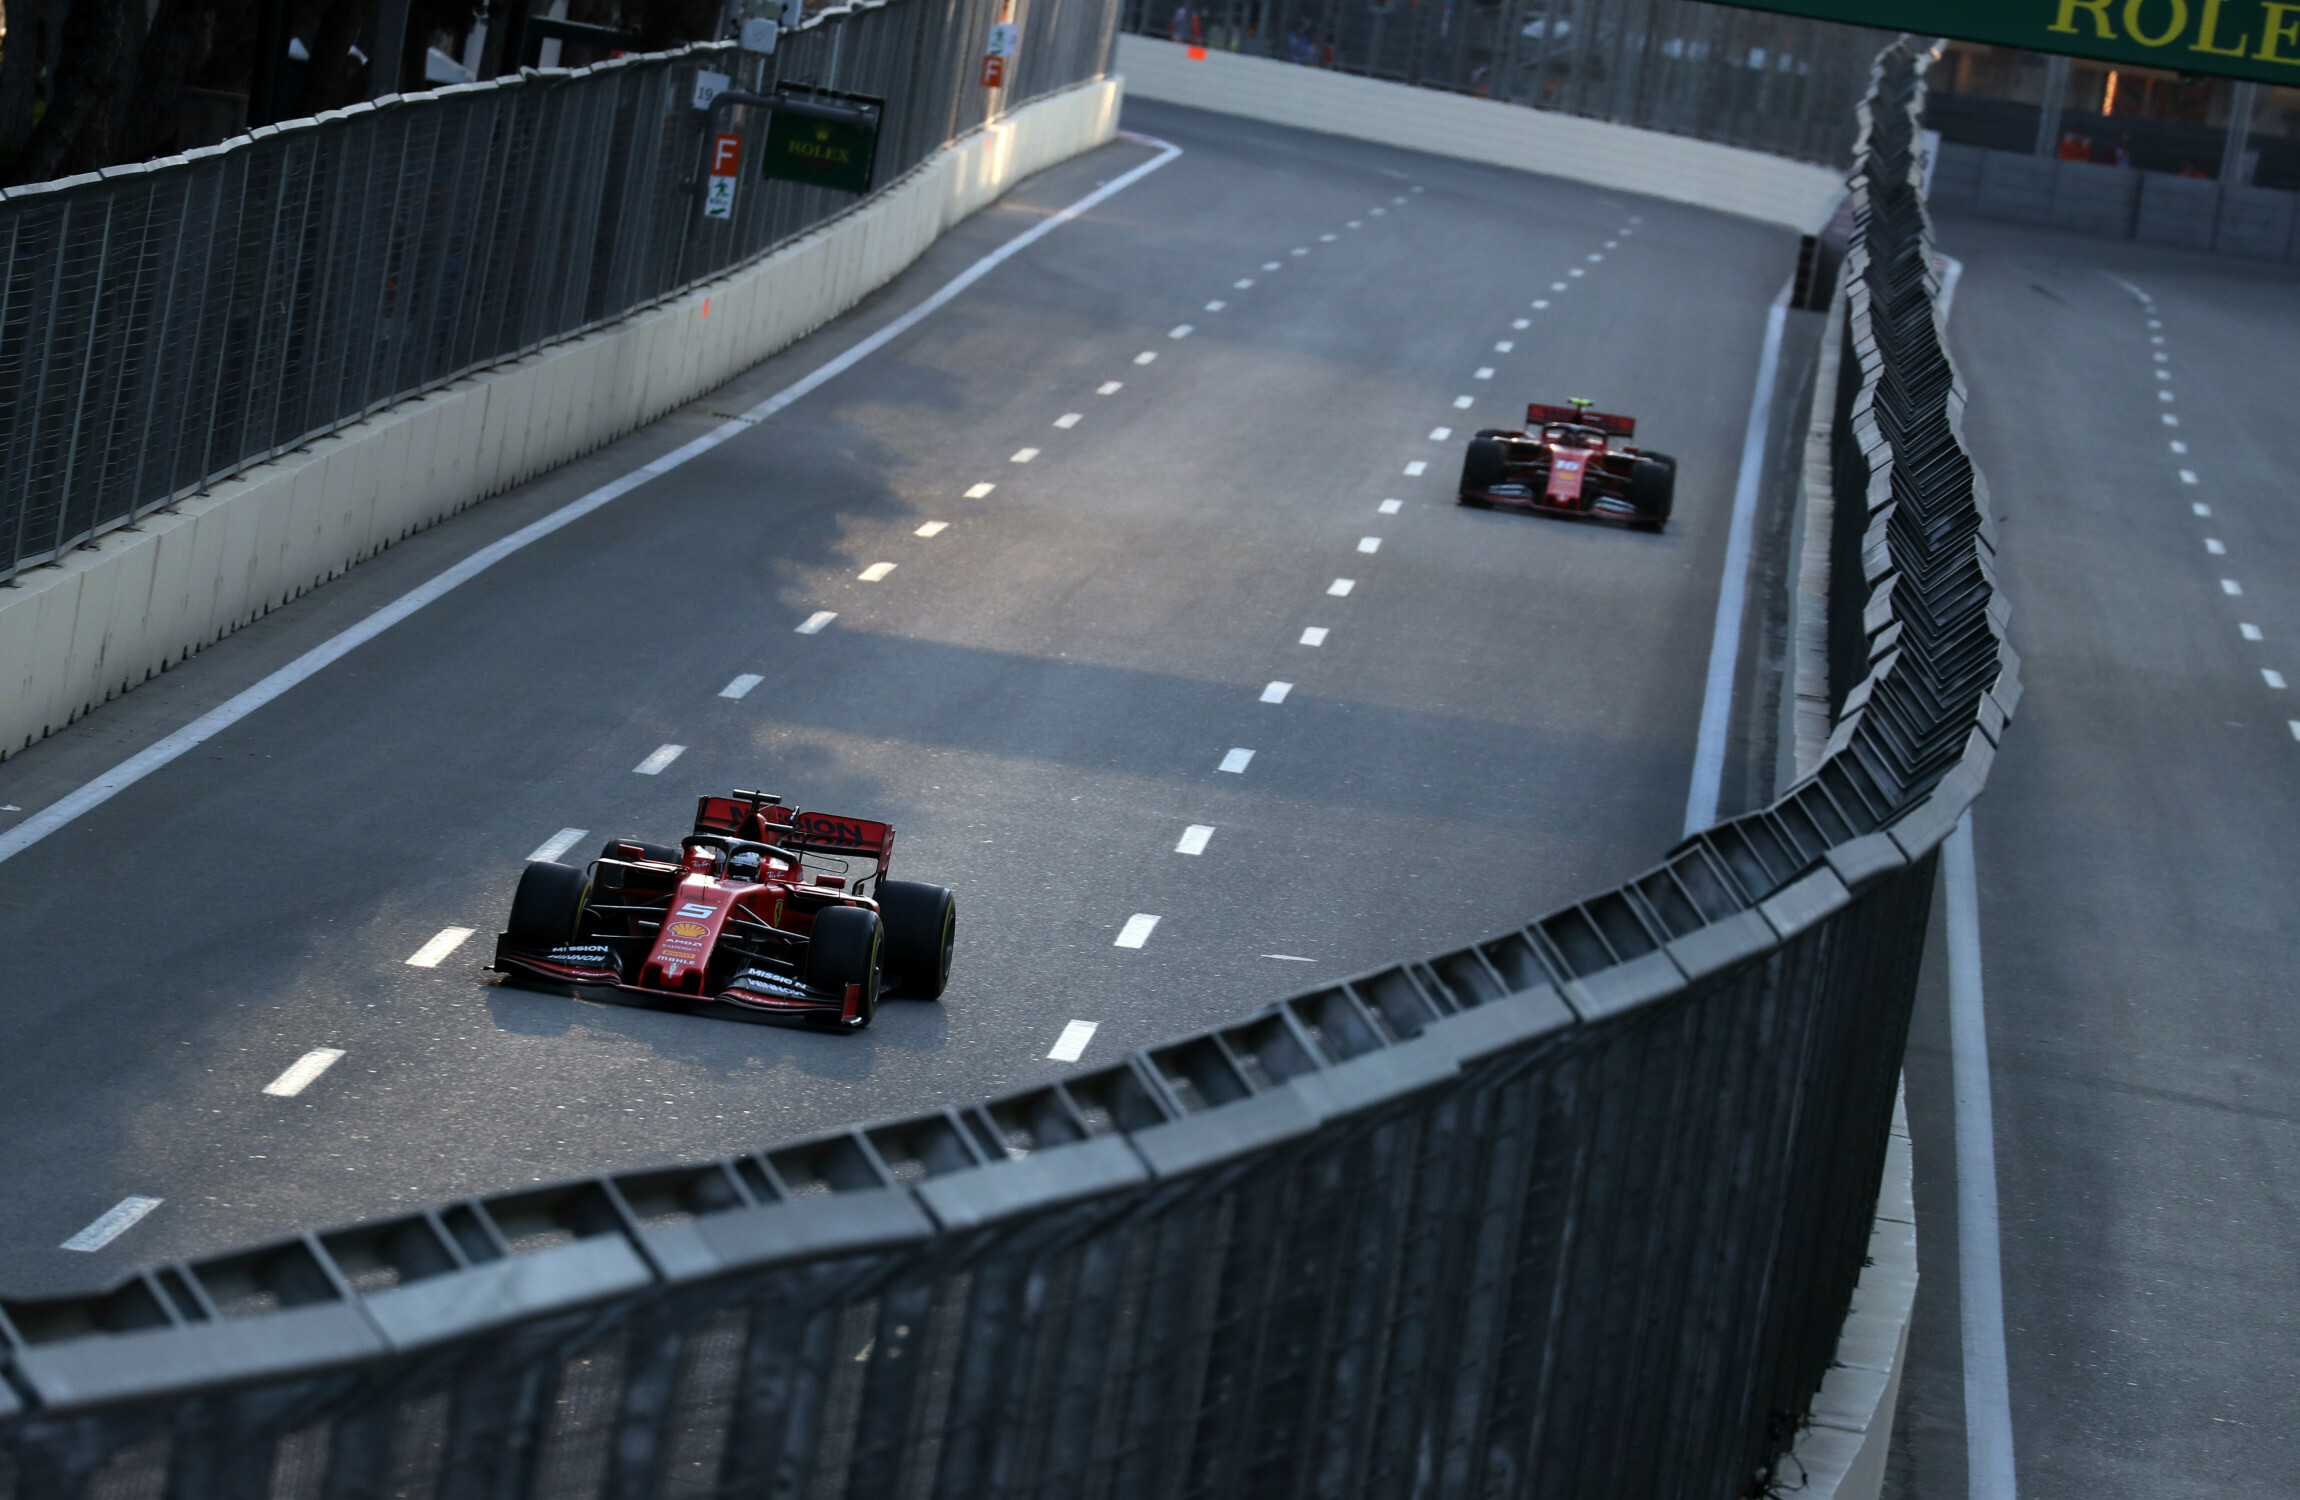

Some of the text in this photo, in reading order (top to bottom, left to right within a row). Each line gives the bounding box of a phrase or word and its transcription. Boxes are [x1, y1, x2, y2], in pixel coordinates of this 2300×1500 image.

[985, 60, 1000, 83] F
[698, 86, 713, 101] 19
[715, 138, 738, 170] F
[788, 140, 849, 163] ROLEX
[1555, 459, 1579, 471] 16
[676, 903, 718, 918] 5
[552, 945, 609, 953] MISSION
[547, 954, 606, 962] WINNOW
[657, 955, 696, 965] MAHLE
[748, 967, 807, 989] MISSION
[747, 977, 807, 997] WINNOW
